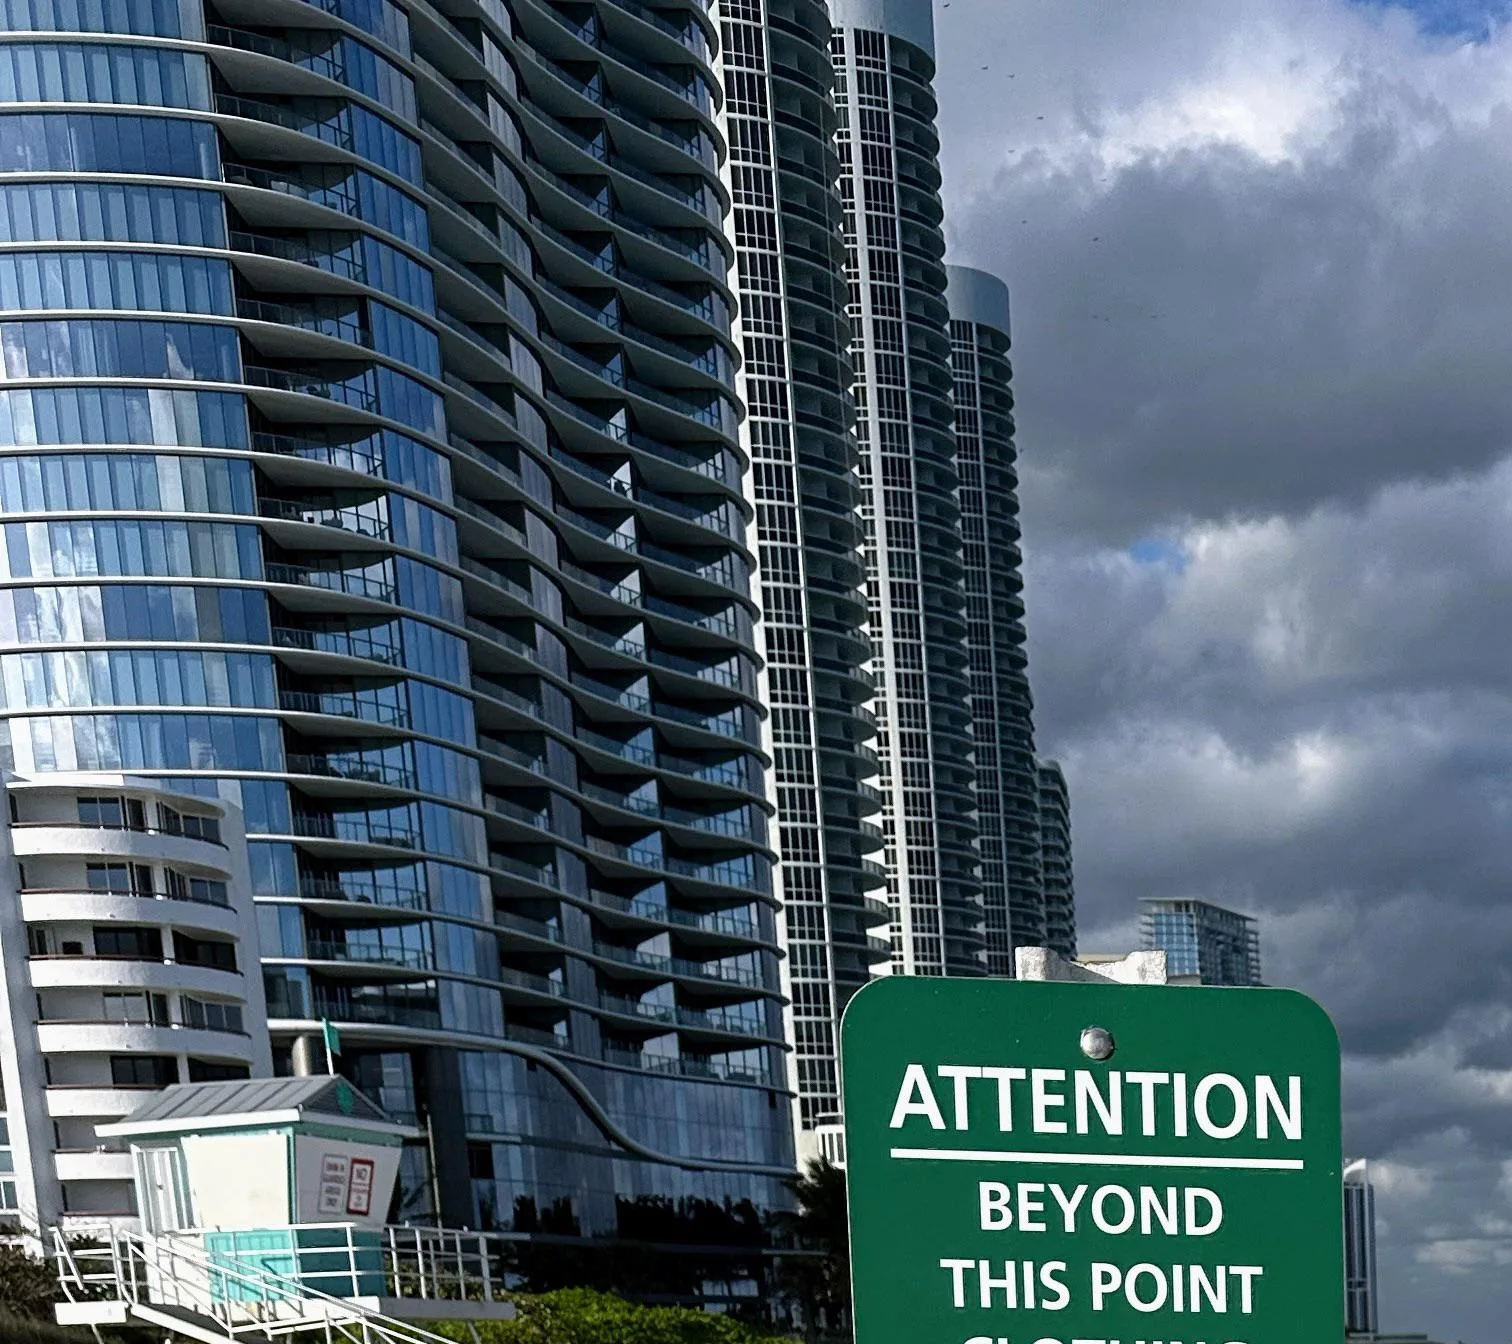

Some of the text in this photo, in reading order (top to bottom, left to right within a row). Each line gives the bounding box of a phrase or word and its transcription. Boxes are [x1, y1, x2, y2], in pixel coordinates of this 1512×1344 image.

[890, 1064, 1301, 1139] ATTENTION
[980, 1182, 1222, 1235] BEYOND
[940, 1259, 1262, 1313] THIS POINT
